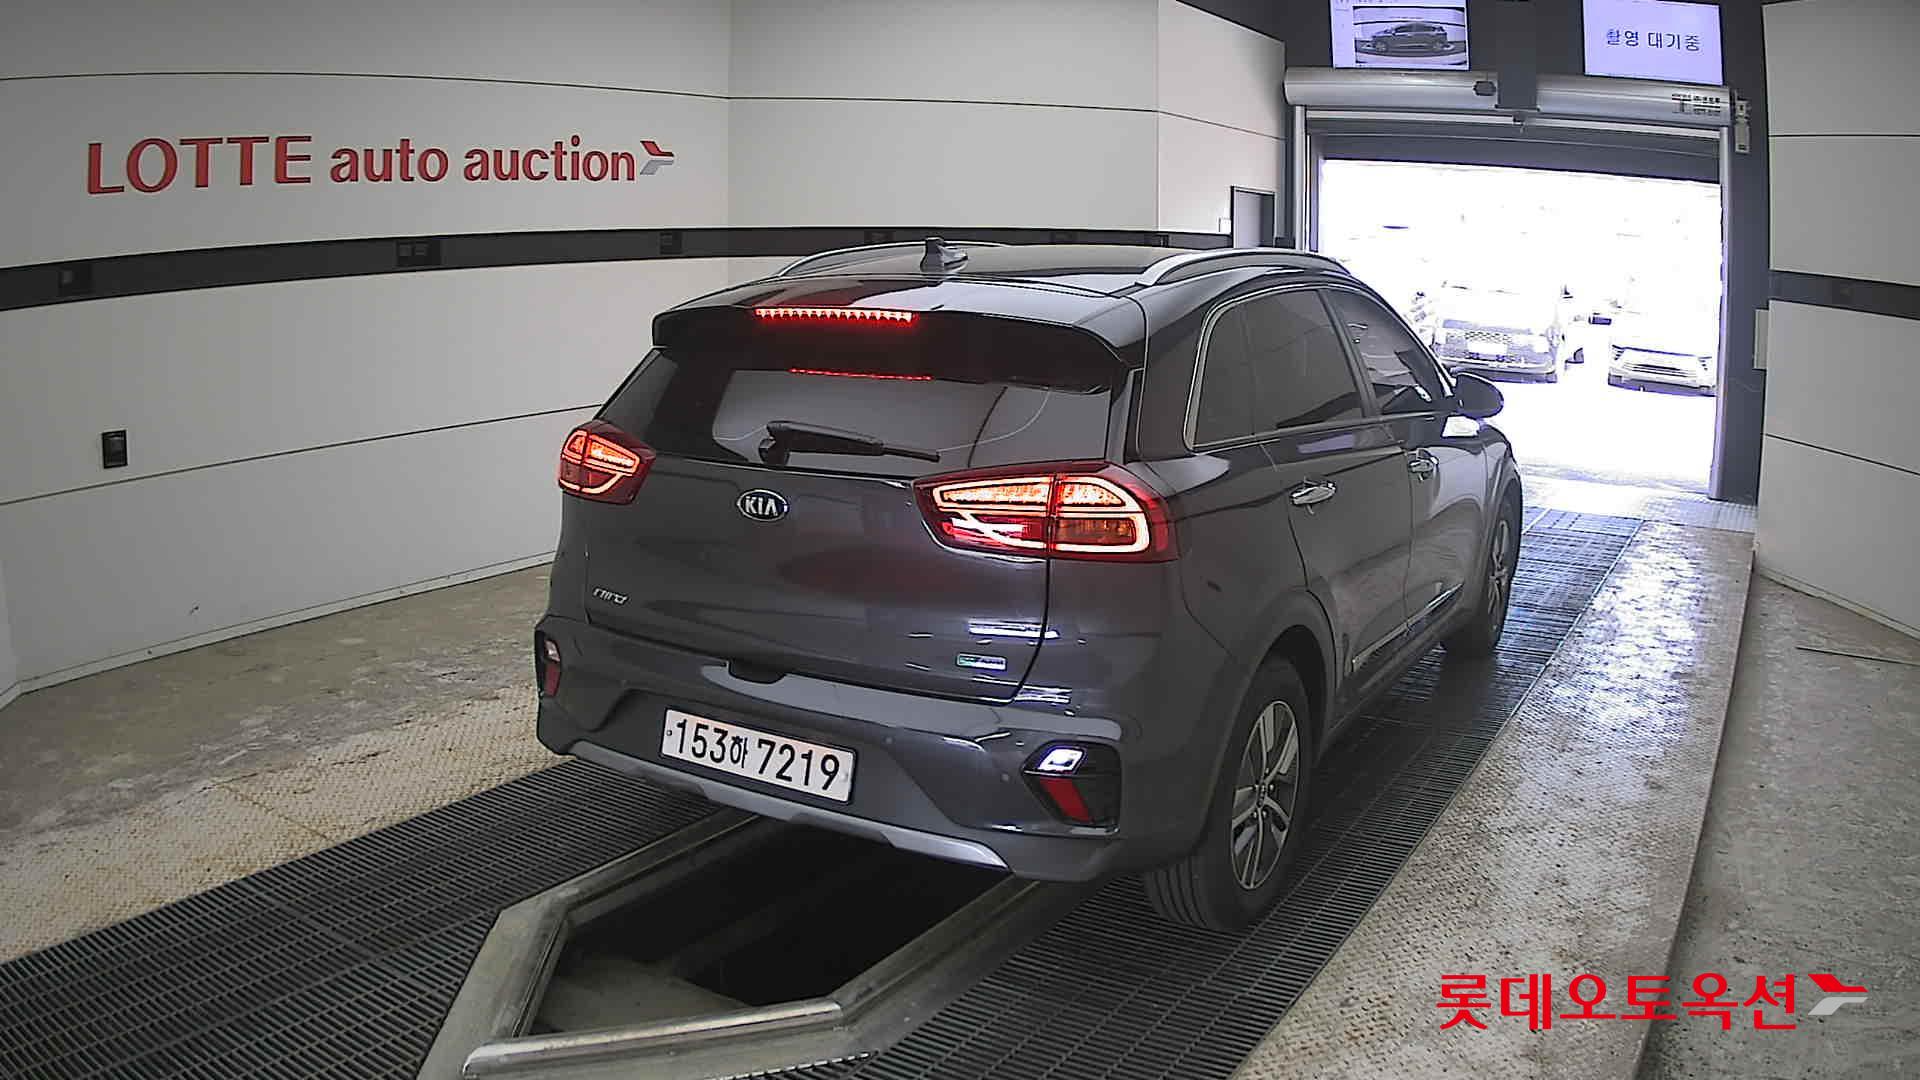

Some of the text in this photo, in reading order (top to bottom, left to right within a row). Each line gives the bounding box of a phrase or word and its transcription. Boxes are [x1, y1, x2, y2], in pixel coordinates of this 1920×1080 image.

[87, 134, 637, 195] LOTTE auto auction
[744, 495, 779, 517] KIA
[757, 737, 840, 791] 7219
